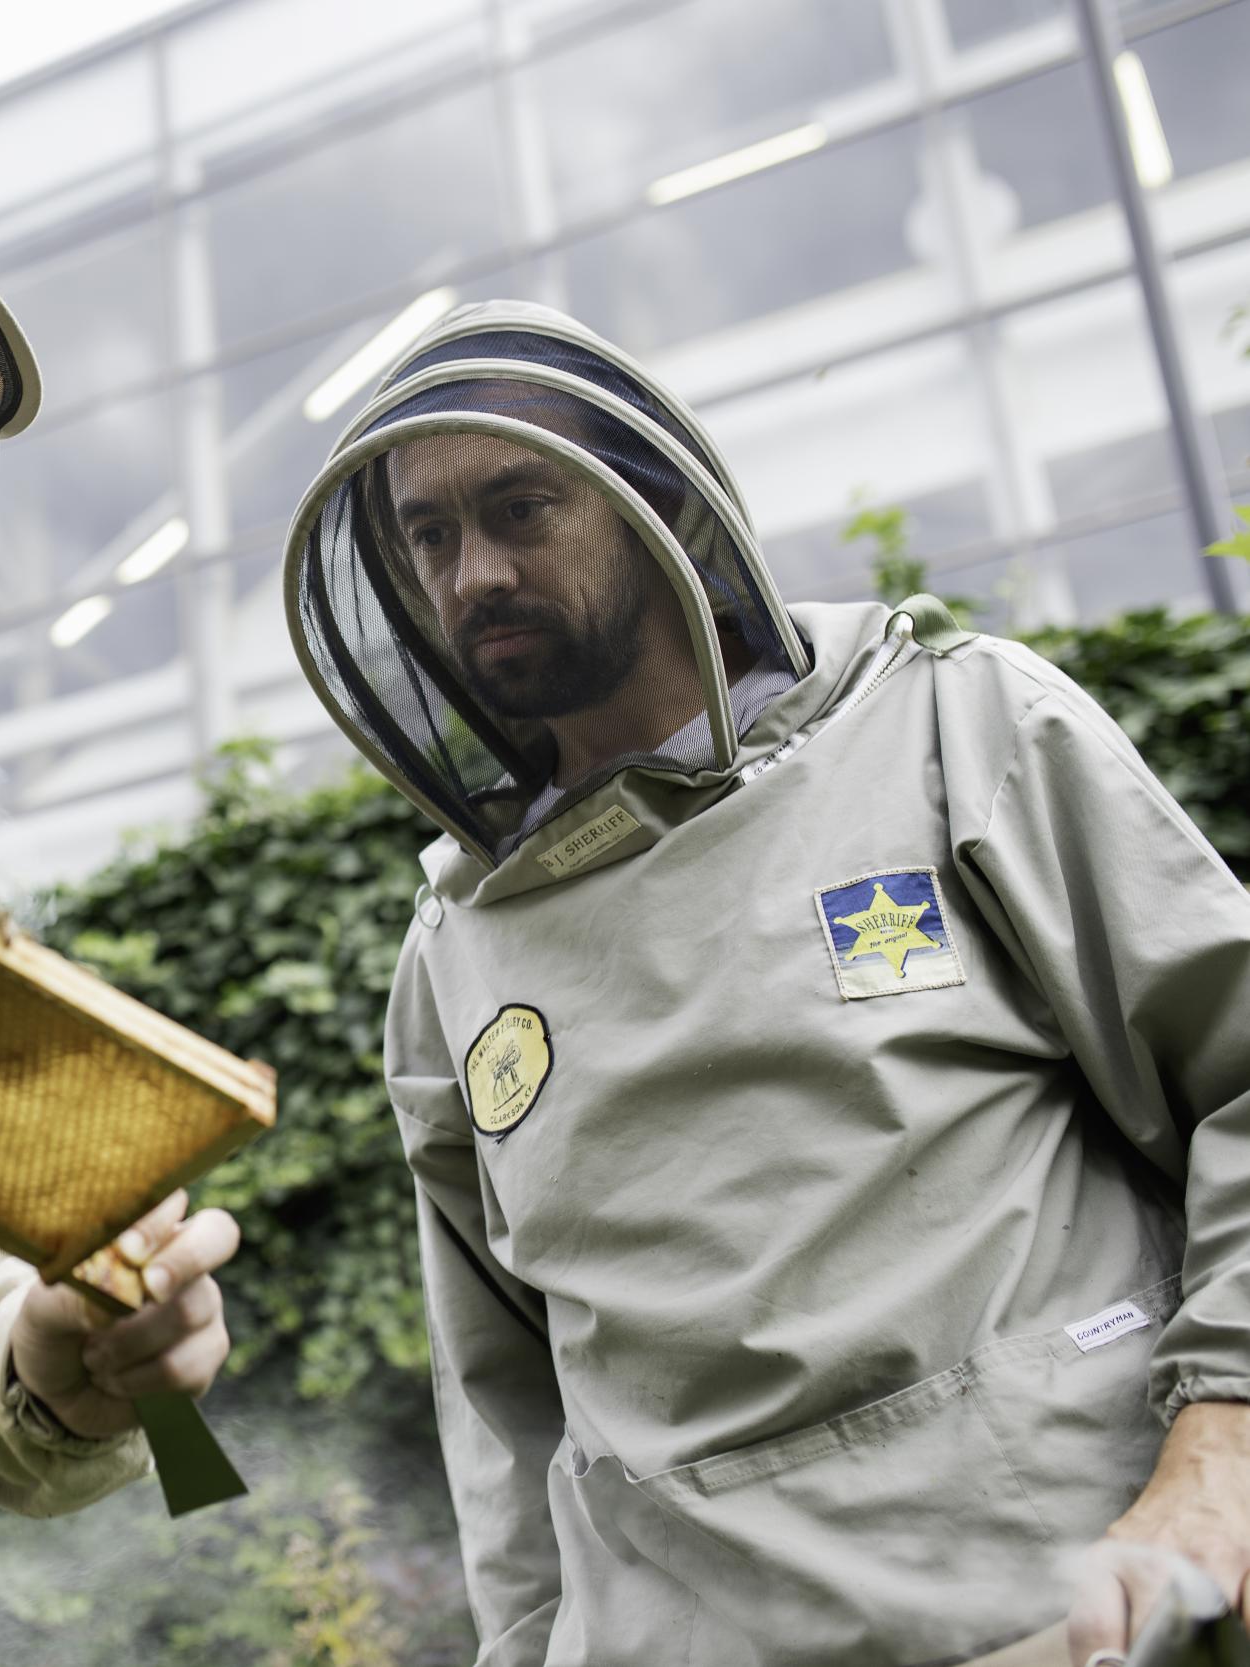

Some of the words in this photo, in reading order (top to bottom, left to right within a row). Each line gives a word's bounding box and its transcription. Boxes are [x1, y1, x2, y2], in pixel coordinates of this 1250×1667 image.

[564, 811, 626, 857] SHERRIFF
[855, 912, 918, 934] SHERRIFF
[521, 1018, 533, 1030] CO.
[1076, 1311, 1135, 1341] COUNTRYMAN
